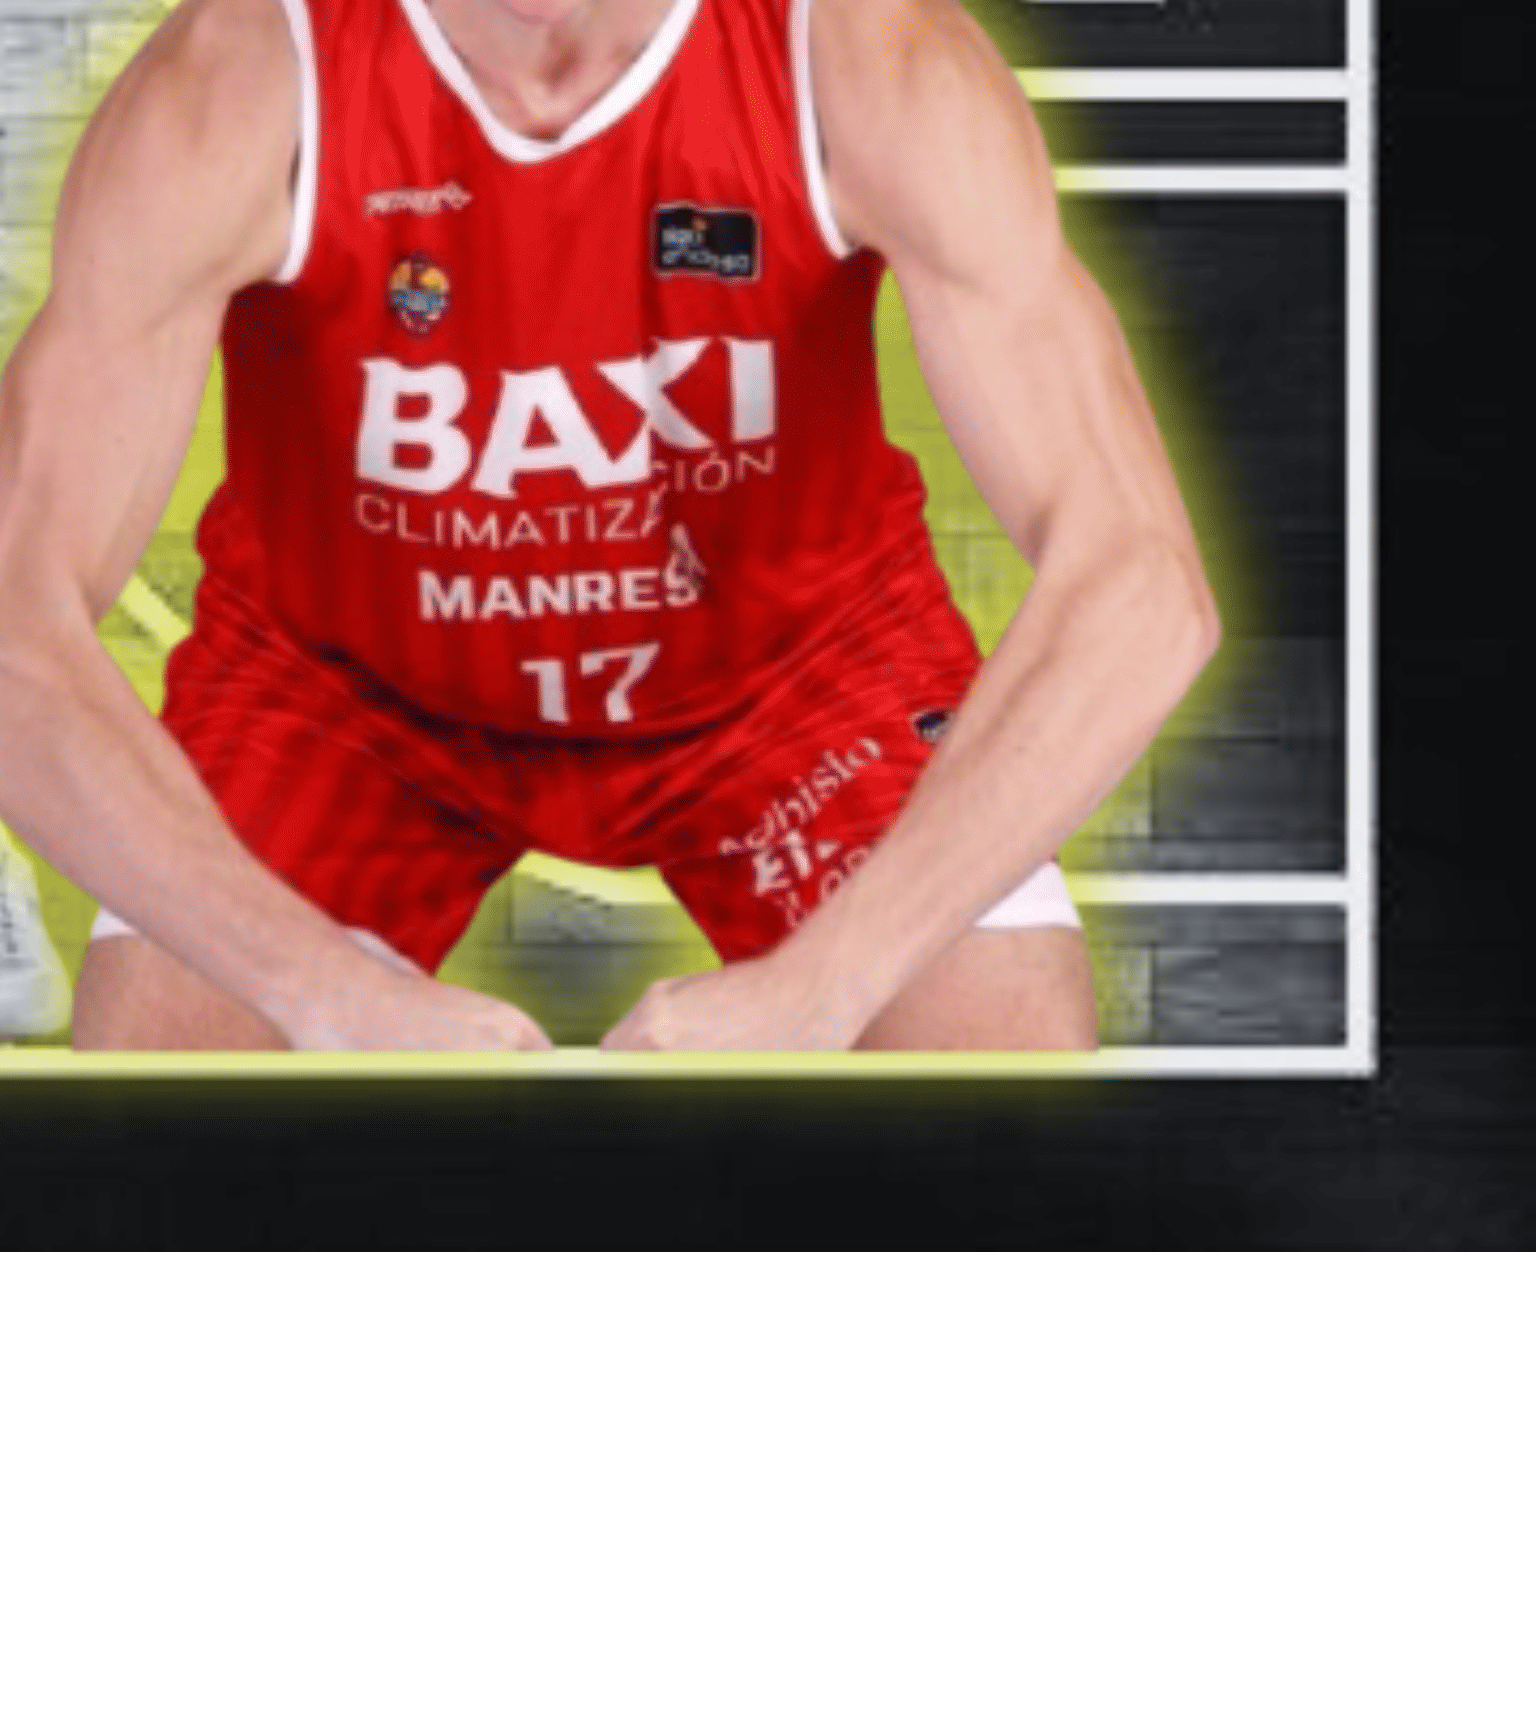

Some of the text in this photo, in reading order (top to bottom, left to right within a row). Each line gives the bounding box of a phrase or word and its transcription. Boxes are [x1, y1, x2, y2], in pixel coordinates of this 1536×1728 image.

[356, 335, 778, 500] BAXI
[353, 445, 778, 553] CLIMATIZIÓN
[521, 641, 662, 726] 17
